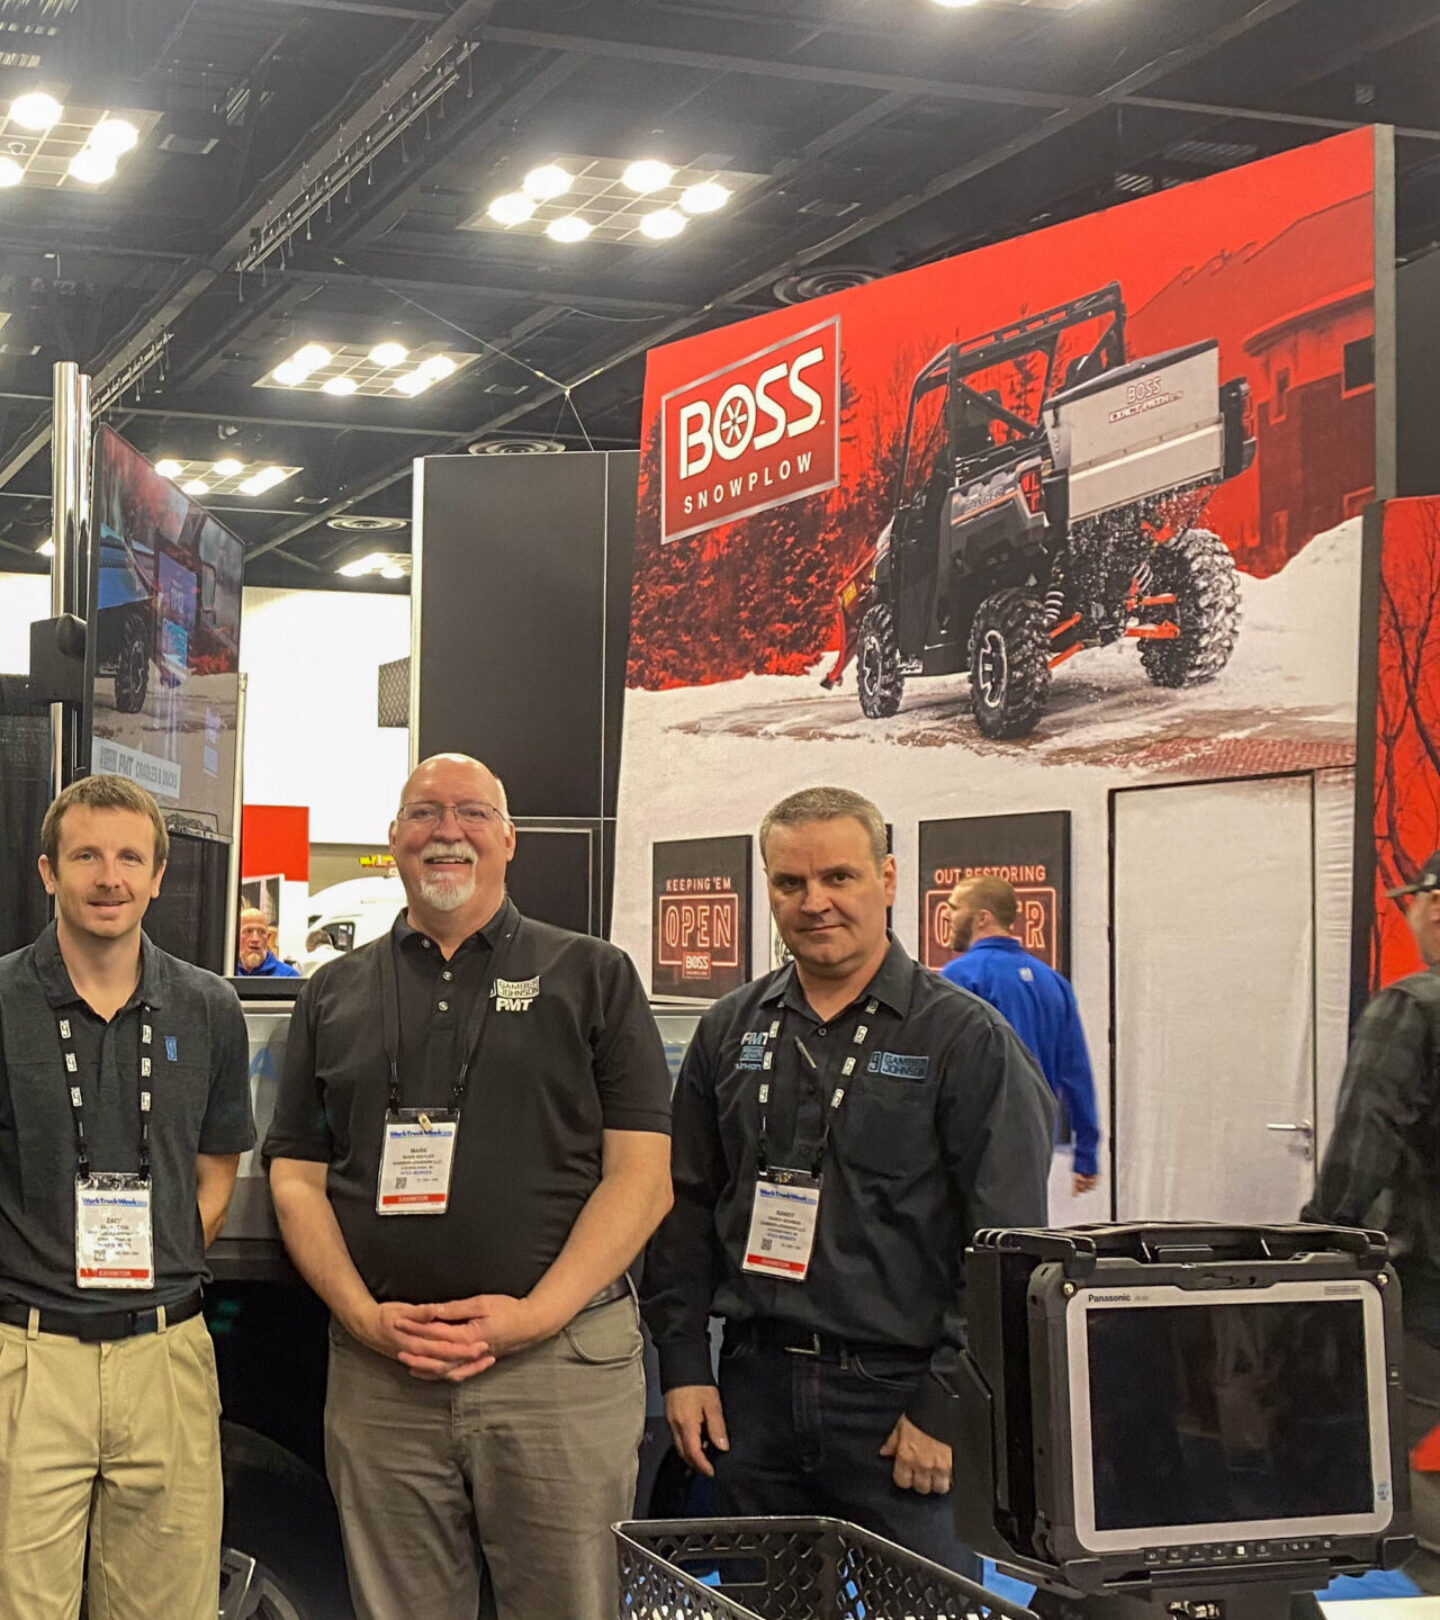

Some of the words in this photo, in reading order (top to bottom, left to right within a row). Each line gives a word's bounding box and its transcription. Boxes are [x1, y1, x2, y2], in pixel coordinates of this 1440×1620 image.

[1127, 375, 1162, 404] BOSS
[680, 345, 824, 480] BOSS
[684, 451, 811, 514] SNOWPLOW
[934, 868, 962, 884] OUT
[666, 877, 710, 892] KEEPING
[665, 904, 731, 948] OPEN
[685, 955, 709, 970] BOSS
[496, 998, 534, 1012] PMT
[1088, 1293, 1131, 1302] Panasonic
